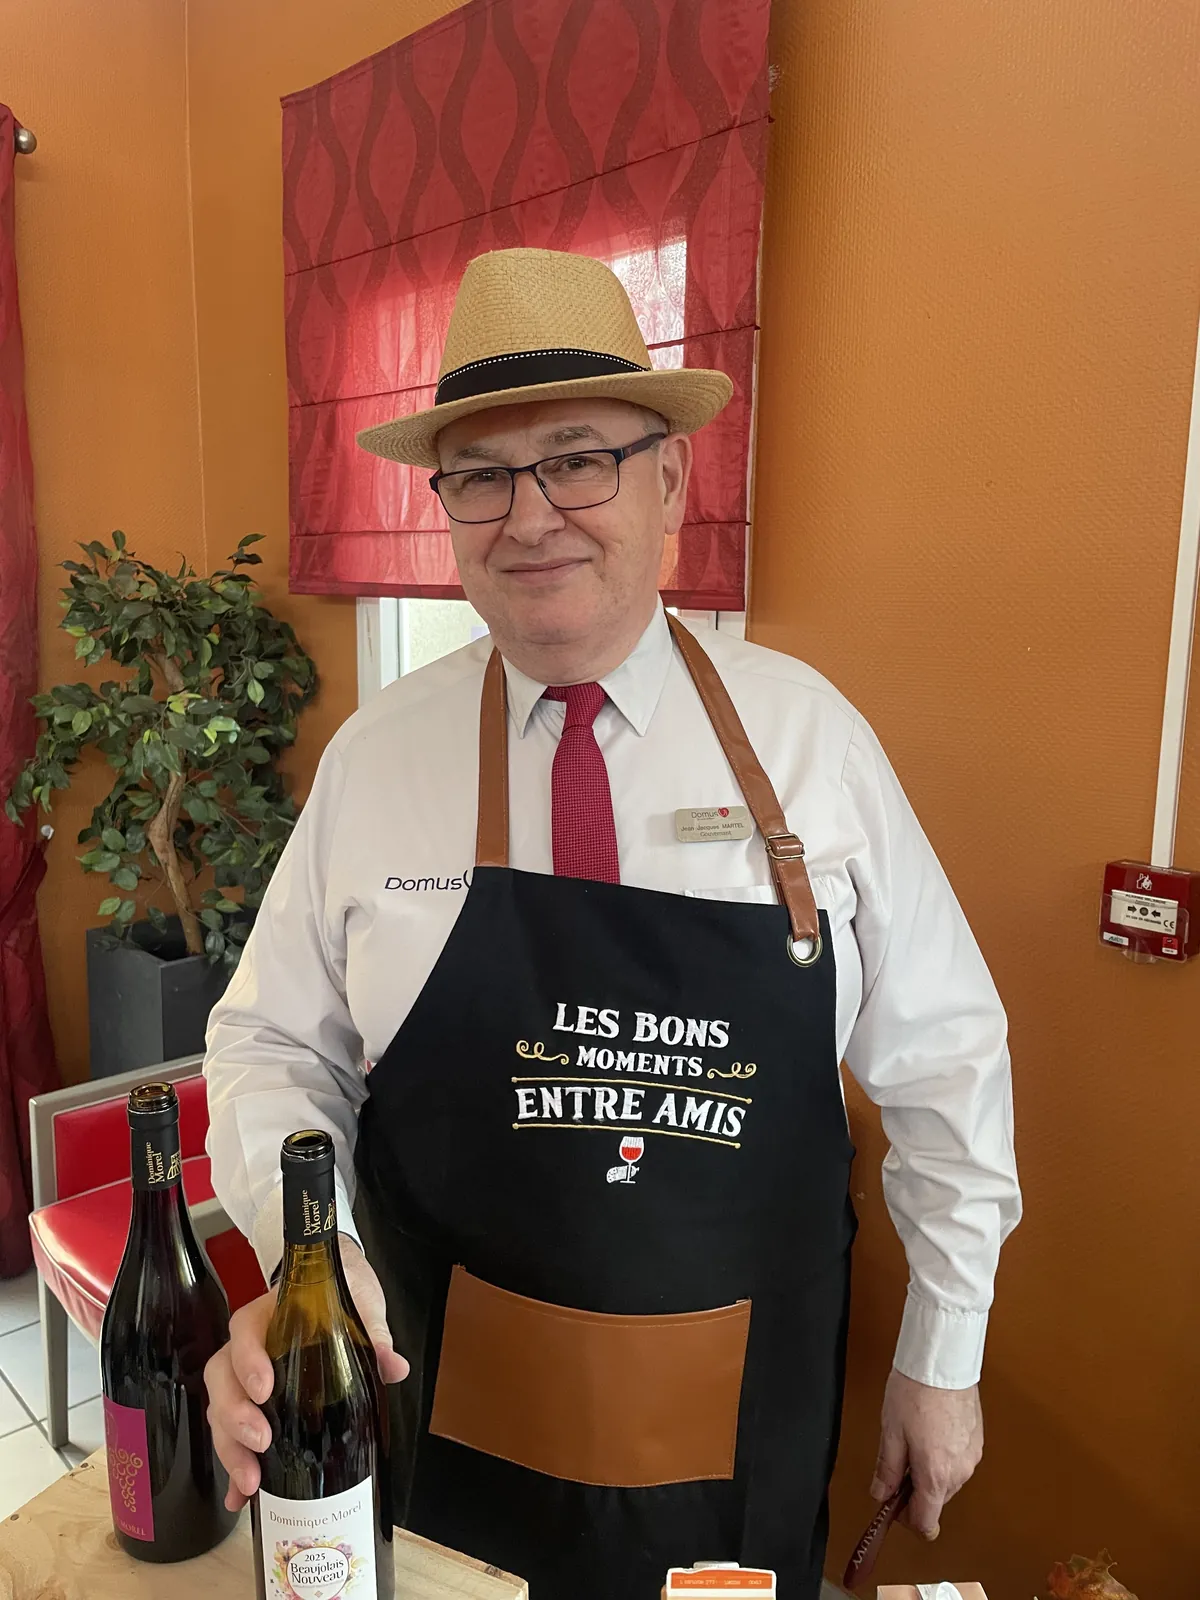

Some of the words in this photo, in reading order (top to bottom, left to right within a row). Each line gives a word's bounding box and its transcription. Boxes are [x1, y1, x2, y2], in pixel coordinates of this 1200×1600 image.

[552, 1002, 620, 1039] LES
[632, 1011, 730, 1048] BONS
[576, 1045, 703, 1077] MOMENTS
[514, 1086, 646, 1121] ENTRE
[652, 1093, 746, 1138] AMIS
[145, 1141, 156, 1184] Dominique
[152, 1152, 165, 1183] Morel
[302, 1189, 312, 1236] Dominique
[309, 1200, 322, 1235] Morel
[269, 1510, 329, 1529] Dominique
[331, 1500, 362, 1522] Morel
[290, 1559, 344, 1576] Beaujolais
[304, 1552, 326, 1562] 2025
[291, 1570, 344, 1585] Nouveau
